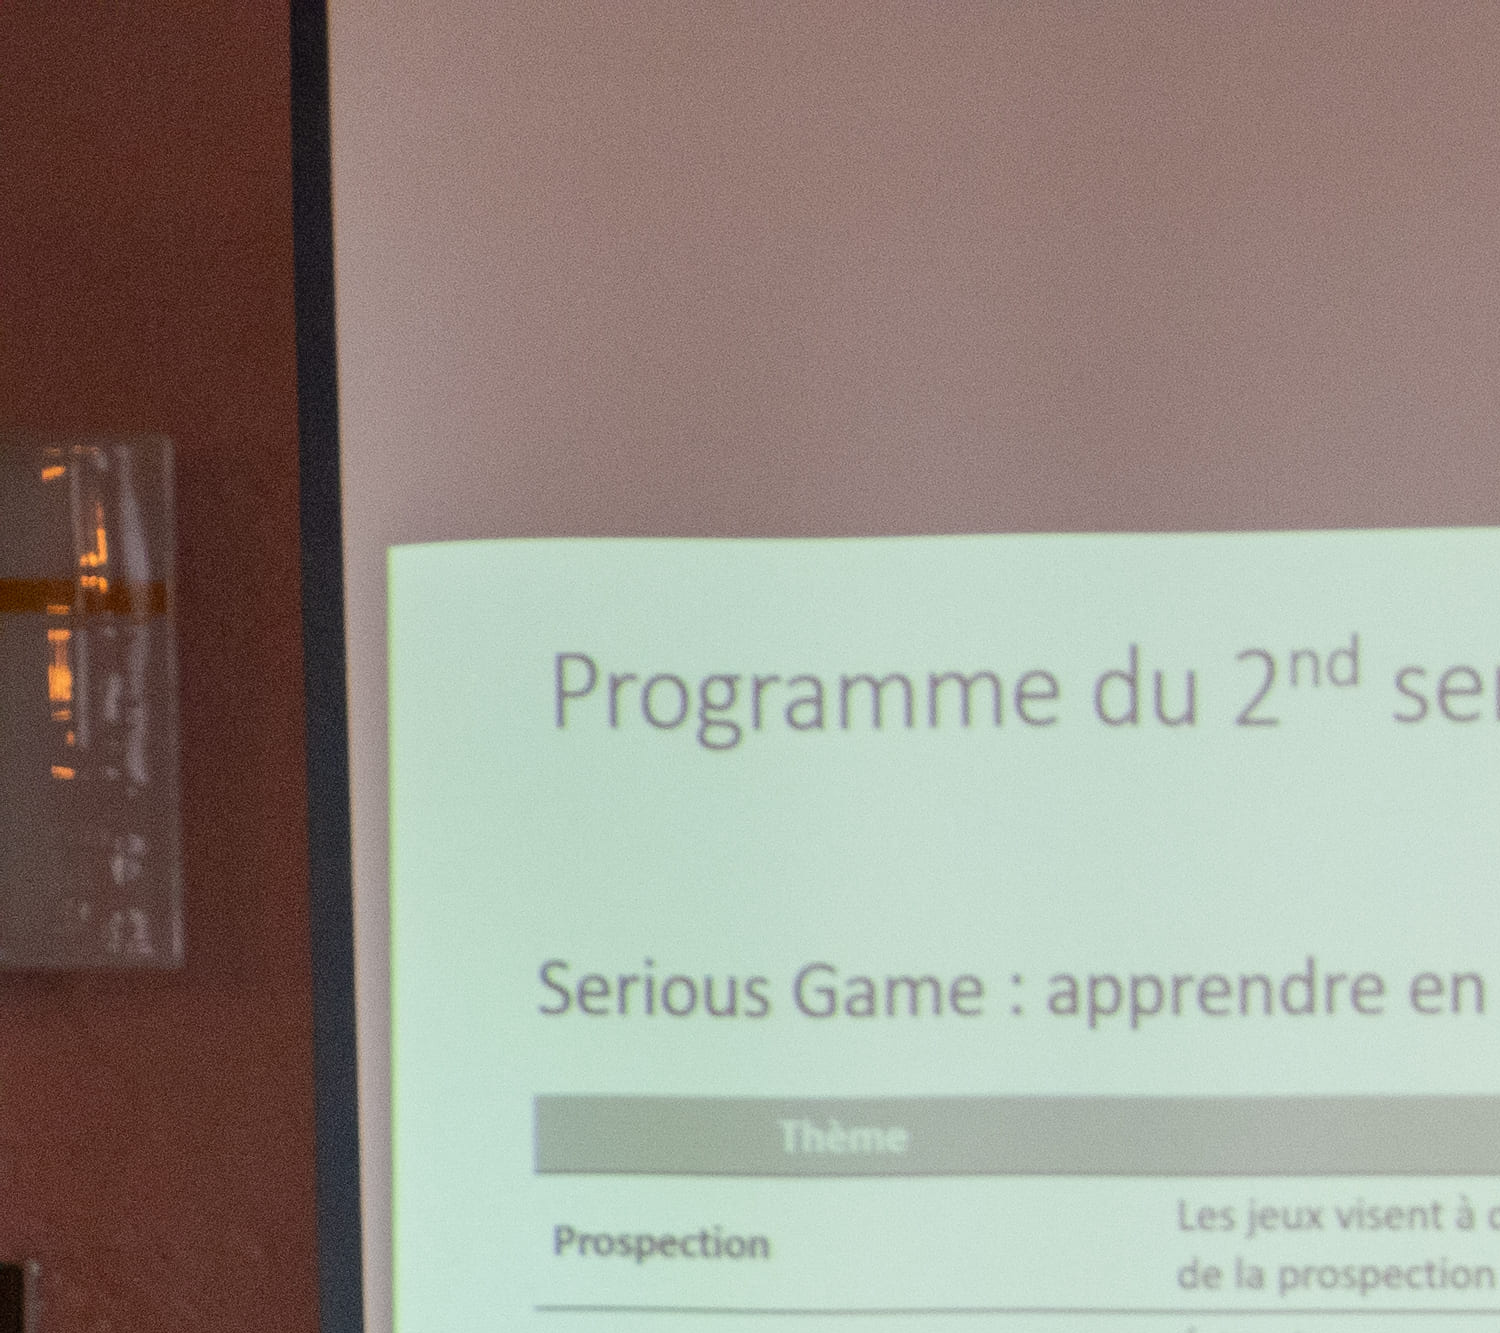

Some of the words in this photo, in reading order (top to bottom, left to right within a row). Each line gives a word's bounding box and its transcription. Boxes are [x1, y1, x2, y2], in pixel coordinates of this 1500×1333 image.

[553, 650, 1062, 753] Programme
[1091, 642, 1199, 729] du
[1235, 630, 1364, 731] 2nd
[536, 957, 774, 1021] Serious
[790, 960, 987, 1021] Game
[1010, 969, 1026, 1019] :
[1045, 955, 1388, 1031] apprendre
[1407, 970, 1488, 1017] en
[777, 1118, 911, 1155] Thème
[1176, 1199, 1239, 1235] Les
[1244, 1200, 1326, 1241] jeux
[1333, 1200, 1445, 1233] visent
[1453, 1195, 1478, 1234] à
[552, 1223, 773, 1265] Prospection
[1175, 1256, 1225, 1293] de
[1232, 1255, 1268, 1293] la
[1276, 1257, 1498, 1298] prospection
